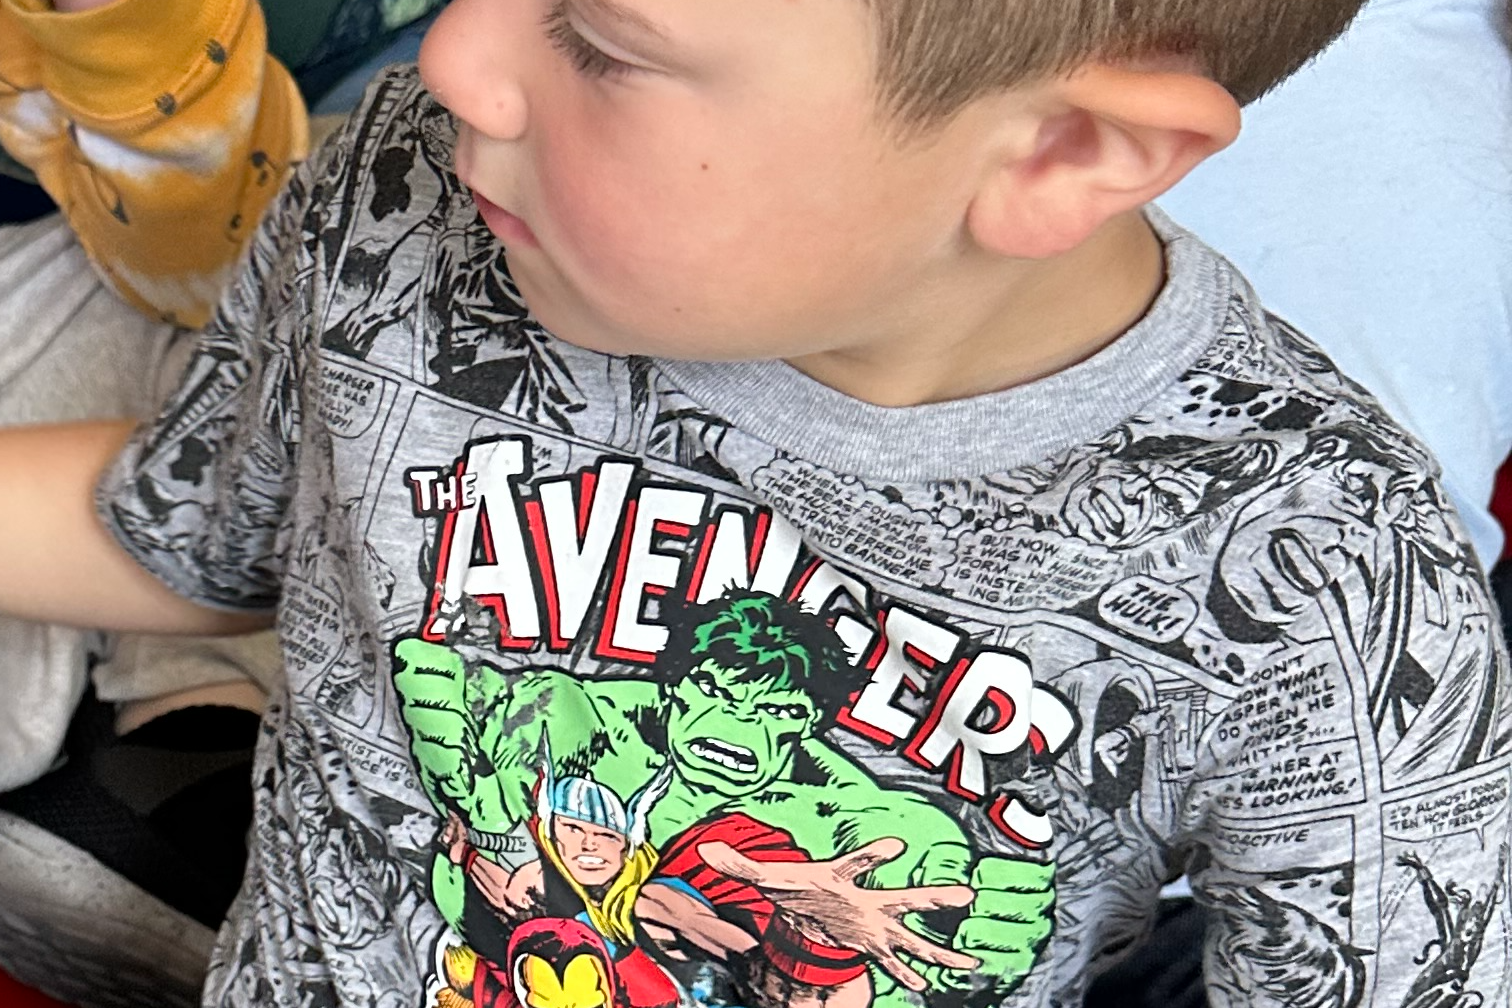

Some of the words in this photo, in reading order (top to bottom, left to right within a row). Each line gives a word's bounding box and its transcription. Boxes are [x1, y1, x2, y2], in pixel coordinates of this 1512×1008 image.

[406, 467, 479, 514] THE
[765, 477, 796, 498] THE
[780, 469, 812, 491] THE
[797, 467, 843, 495] WHEN
[860, 500, 926, 533] FOUGHT
[761, 489, 796, 514] TION
[799, 505, 907, 561] TRANSFERRED
[903, 555, 933, 572] ME
[808, 526, 843, 549] INTO
[980, 535, 1014, 547] BUT
[980, 548, 1021, 563] WAS
[1025, 553, 1047, 568] IN
[953, 566, 972, 581] IS
[1130, 582, 1181, 612] THE
[1103, 594, 1185, 637] HULK!
[423, 435, 1081, 849] AVENGERS
[1276, 662, 1329, 692] WHAT
[1221, 696, 1281, 725] ASPER
[1290, 679, 1336, 702] WILL
[1218, 725, 1240, 742] DO
[1247, 705, 1299, 733] WHEN
[1307, 693, 1335, 713] HE
[1271, 756, 1312, 775] HER
[1319, 751, 1342, 768] AT
[1241, 767, 1336, 794] WARNING
[1251, 777, 1357, 809] LOOKING!
